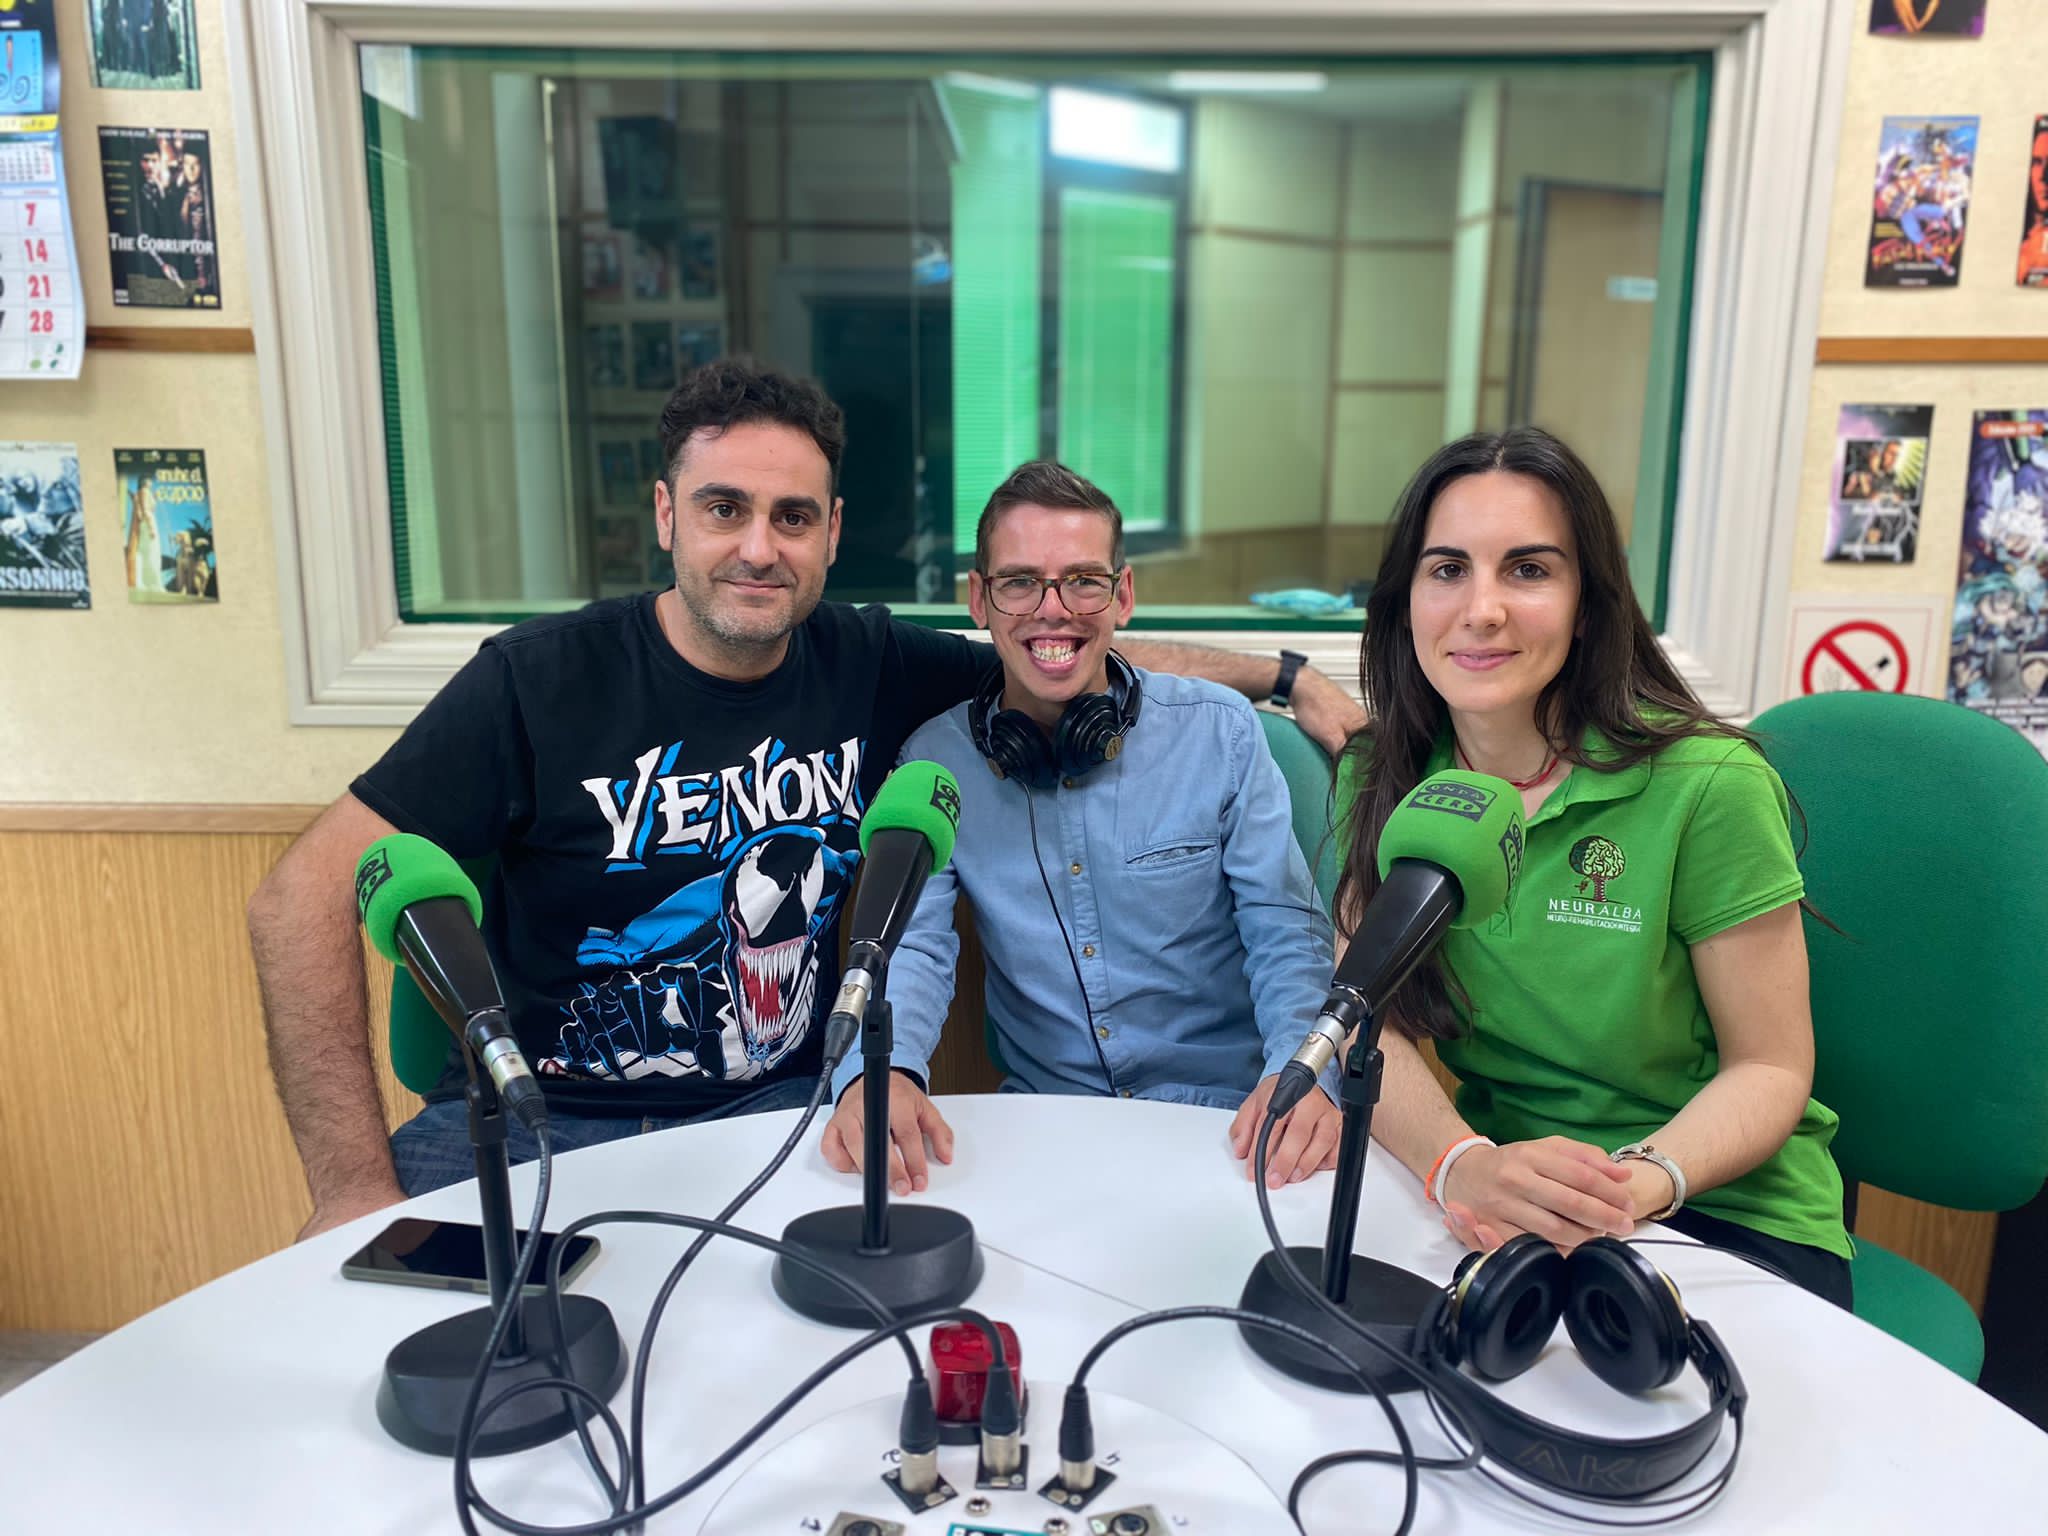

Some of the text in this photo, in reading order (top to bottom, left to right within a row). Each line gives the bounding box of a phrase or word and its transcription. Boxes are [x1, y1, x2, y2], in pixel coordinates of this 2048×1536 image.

[25, 203, 36, 226] 7
[25, 239, 48, 263] 14
[109, 232, 214, 255] THE CORRUPTOR
[28, 274, 51, 298] 21
[30, 310, 54, 333] 28
[580, 736, 864, 862] VENOM
[1423, 795, 1474, 811] CERO
